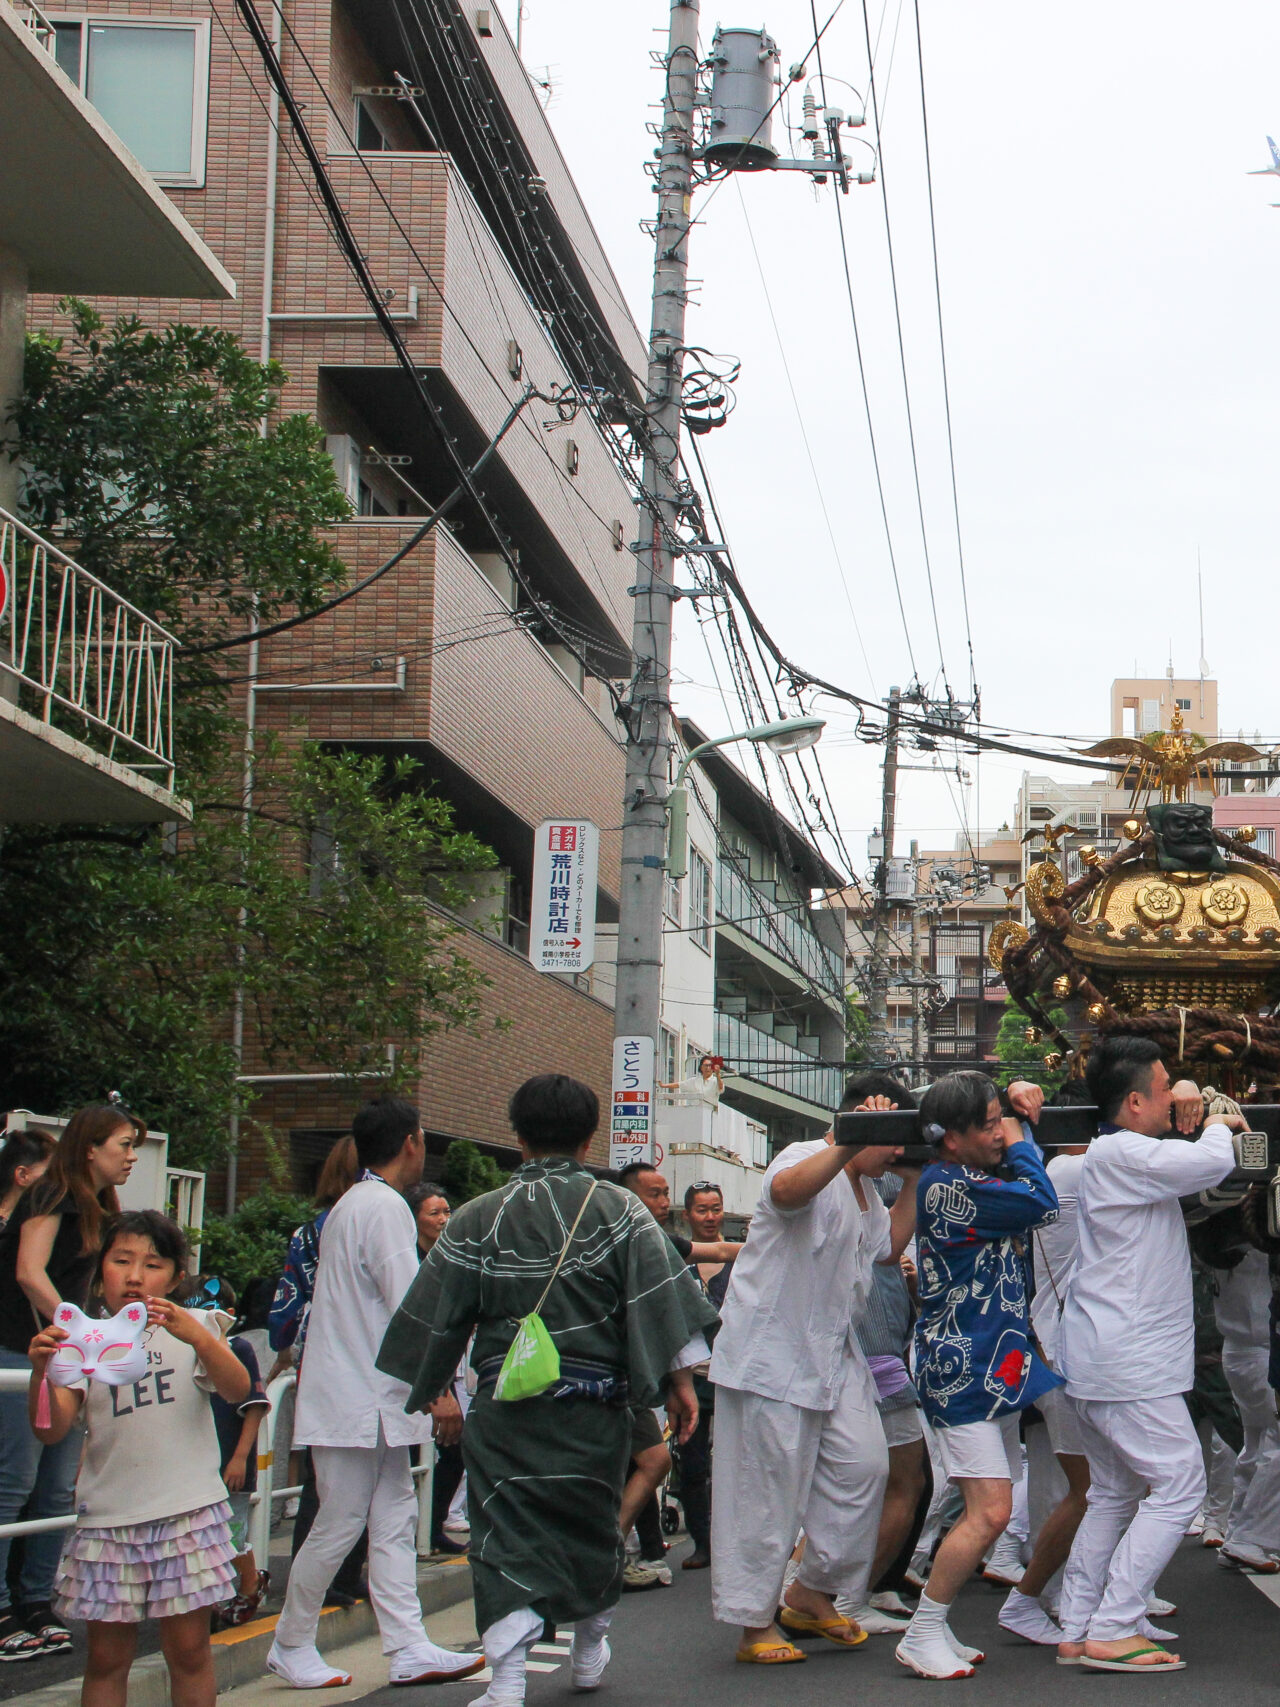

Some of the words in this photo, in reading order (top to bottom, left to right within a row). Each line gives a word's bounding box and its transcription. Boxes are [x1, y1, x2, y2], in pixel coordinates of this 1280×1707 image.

[564, 827, 574, 851] メガネ
[548, 854, 572, 933] 荒川時計店
[623, 1041, 640, 1089] さとう
[617, 1092, 645, 1102] 内科
[616, 1106, 645, 1115] 外科
[614, 1133, 646, 1143] 肛門外科
[109, 1368, 175, 1417] LEE
